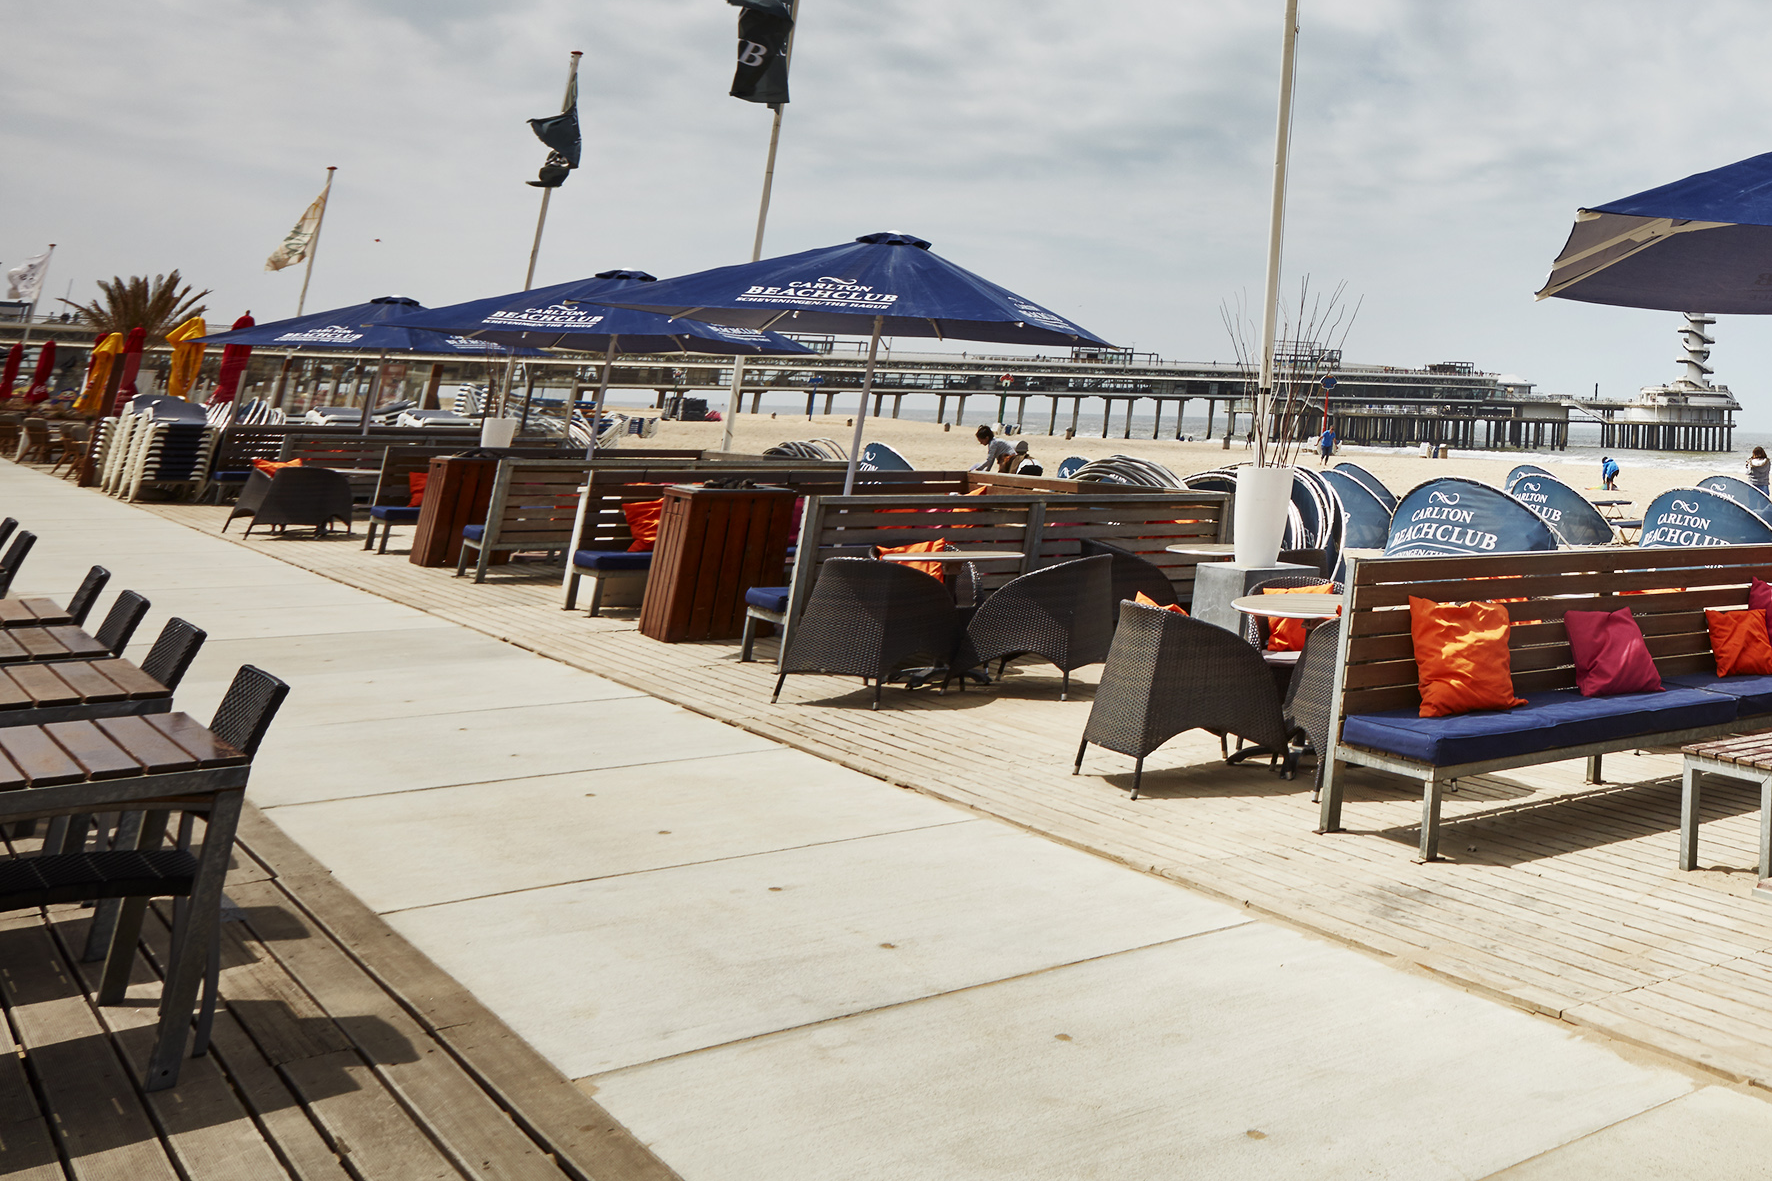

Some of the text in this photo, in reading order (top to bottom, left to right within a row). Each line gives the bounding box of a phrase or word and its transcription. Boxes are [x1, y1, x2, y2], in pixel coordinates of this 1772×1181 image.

[744, 285, 899, 303] BEACHCLUB
[788, 281, 873, 292] CARLTON
[491, 310, 604, 323] BEACHCLUB
[525, 307, 588, 316] CARLTON
[1411, 506, 1475, 524] CARLTON
[1657, 513, 1711, 530] CARLTON
[1389, 523, 1498, 550] BEACHCLUB
